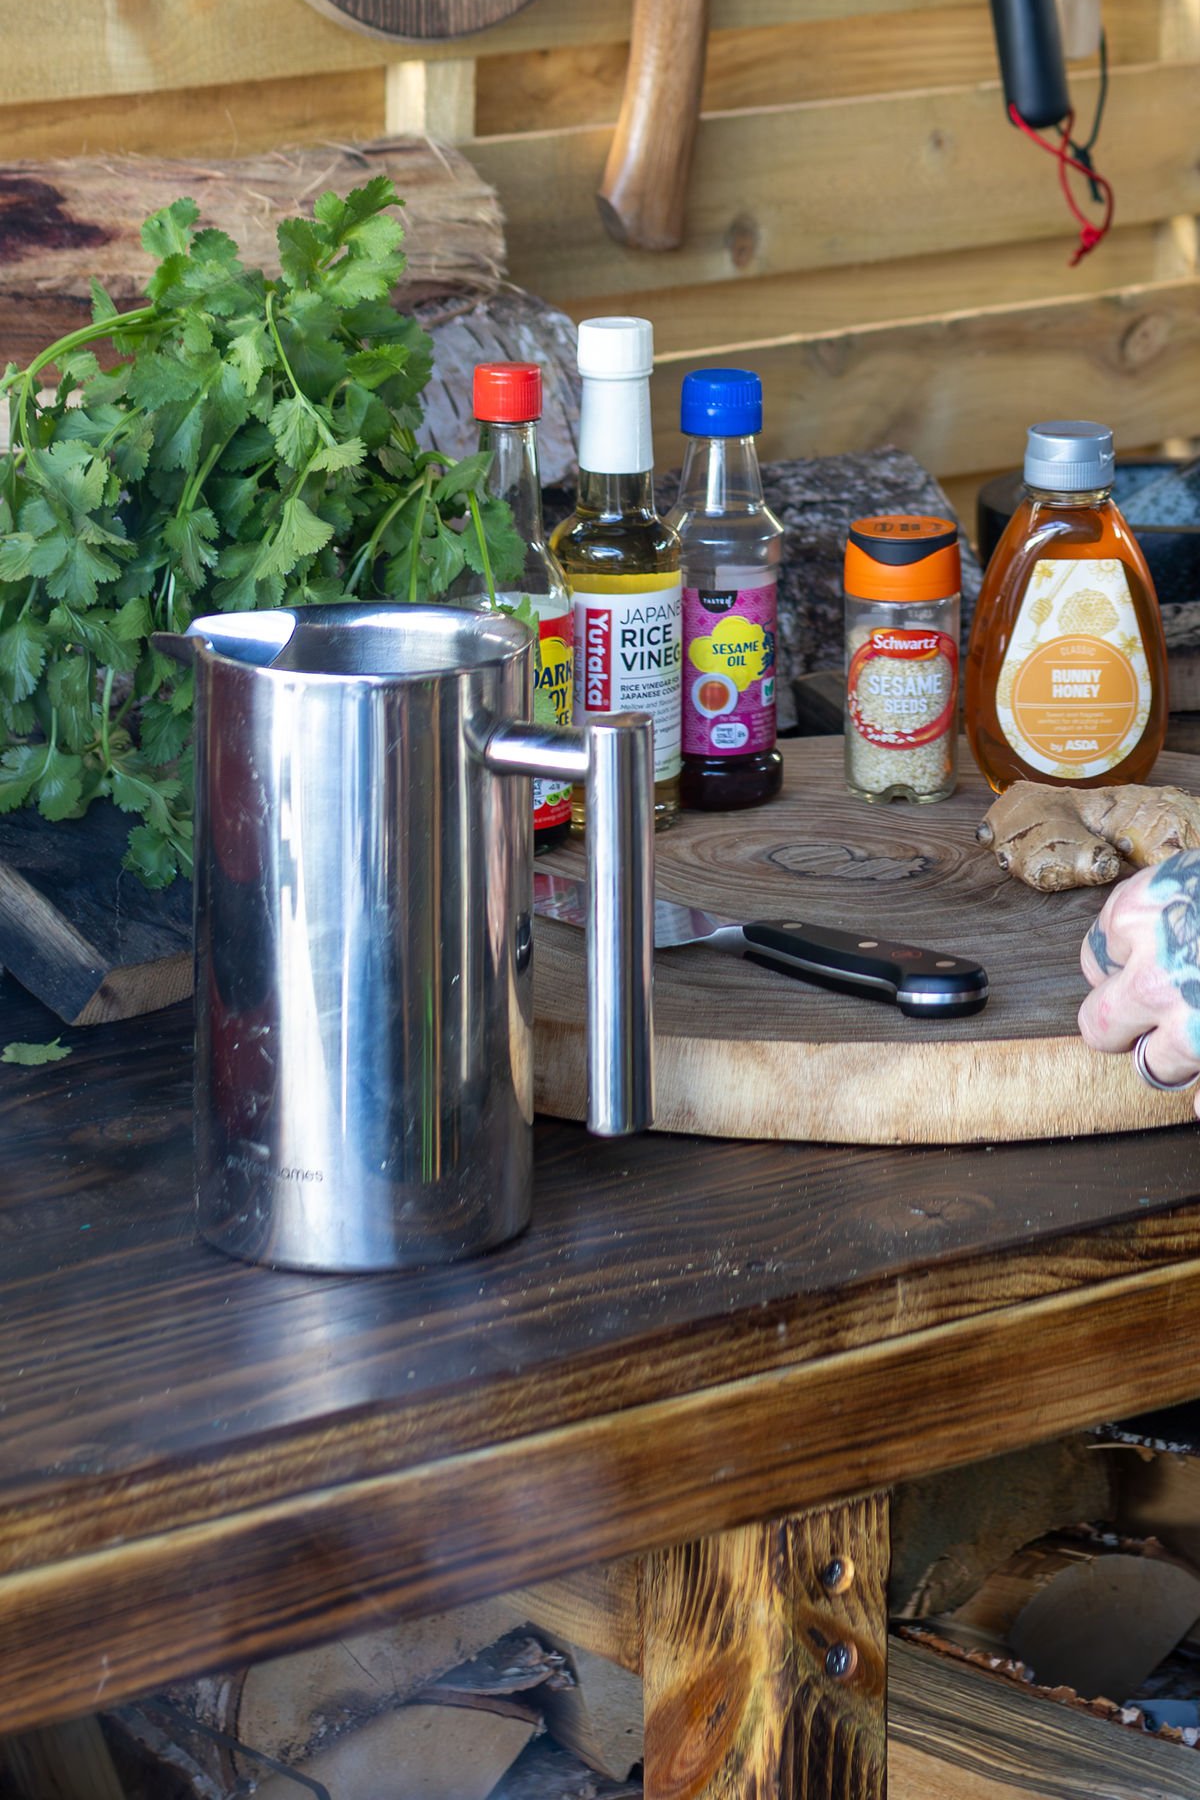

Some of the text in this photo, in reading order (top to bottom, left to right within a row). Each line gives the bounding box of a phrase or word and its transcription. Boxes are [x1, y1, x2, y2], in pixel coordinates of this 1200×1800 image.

[621, 623, 673, 648] RICE
[873, 634, 939, 650] Schwartz
[712, 641, 759, 654] SESAME
[588, 613, 608, 706] Yutaka
[727, 655, 747, 667] OIL
[1052, 669, 1102, 683] RUNNY
[868, 673, 943, 697] SESAME
[1052, 684, 1100, 698] HONEY
[884, 698, 928, 714] SEEDS
[1064, 739, 1099, 750] ASDA
